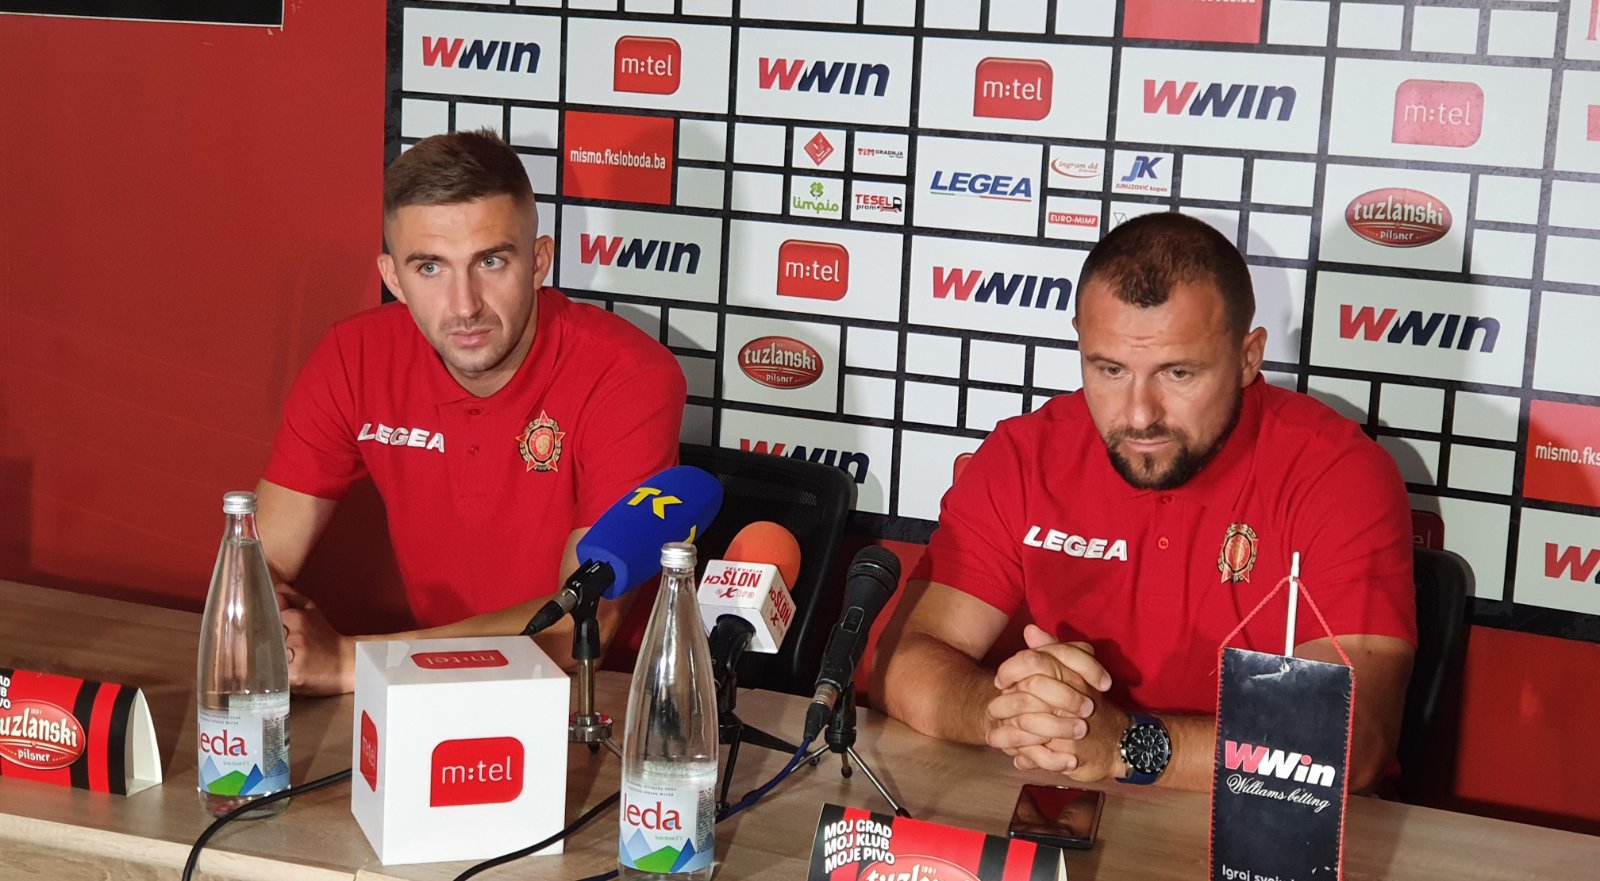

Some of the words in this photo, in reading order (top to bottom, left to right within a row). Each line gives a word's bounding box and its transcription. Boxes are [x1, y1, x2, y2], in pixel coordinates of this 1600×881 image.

[621, 54, 673, 77] m:tel
[983, 77, 1042, 101] m:tel
[1404, 101, 1471, 126] m:tel
[570, 147, 666, 169] mismo.fksloboda.ba
[930, 171, 1032, 197] LEGEA
[793, 196, 839, 214] limpio
[855, 194, 892, 206] TESEL
[1353, 195, 1444, 225] tuzlanski
[1050, 214, 1097, 226] EURO-MIMF
[1380, 229, 1414, 240] pilsner
[785, 259, 839, 282] m:tel
[744, 342, 816, 370] tuzlanski
[766, 373, 793, 383] pilsner
[357, 423, 445, 453] LEGEA
[627, 487, 683, 520] TK
[1023, 525, 1128, 561] LEGEA
[720, 570, 761, 588] SLON
[0, 707, 78, 747] uzlanski
[17, 748, 51, 761] pilsner
[442, 755, 512, 785] m:tel
[1226, 774, 1287, 800] Williams
[1287, 788, 1331, 813] betting
[624, 793, 682, 831] leda
[824, 819, 854, 841] MOJ
[855, 819, 892, 839] GRAD
[824, 834, 854, 857] MOJ
[856, 833, 890, 850] KLUB
[824, 848, 861, 874] MOJE
[863, 847, 895, 865] PIVO
[1222, 864, 1250, 881] Igraj
